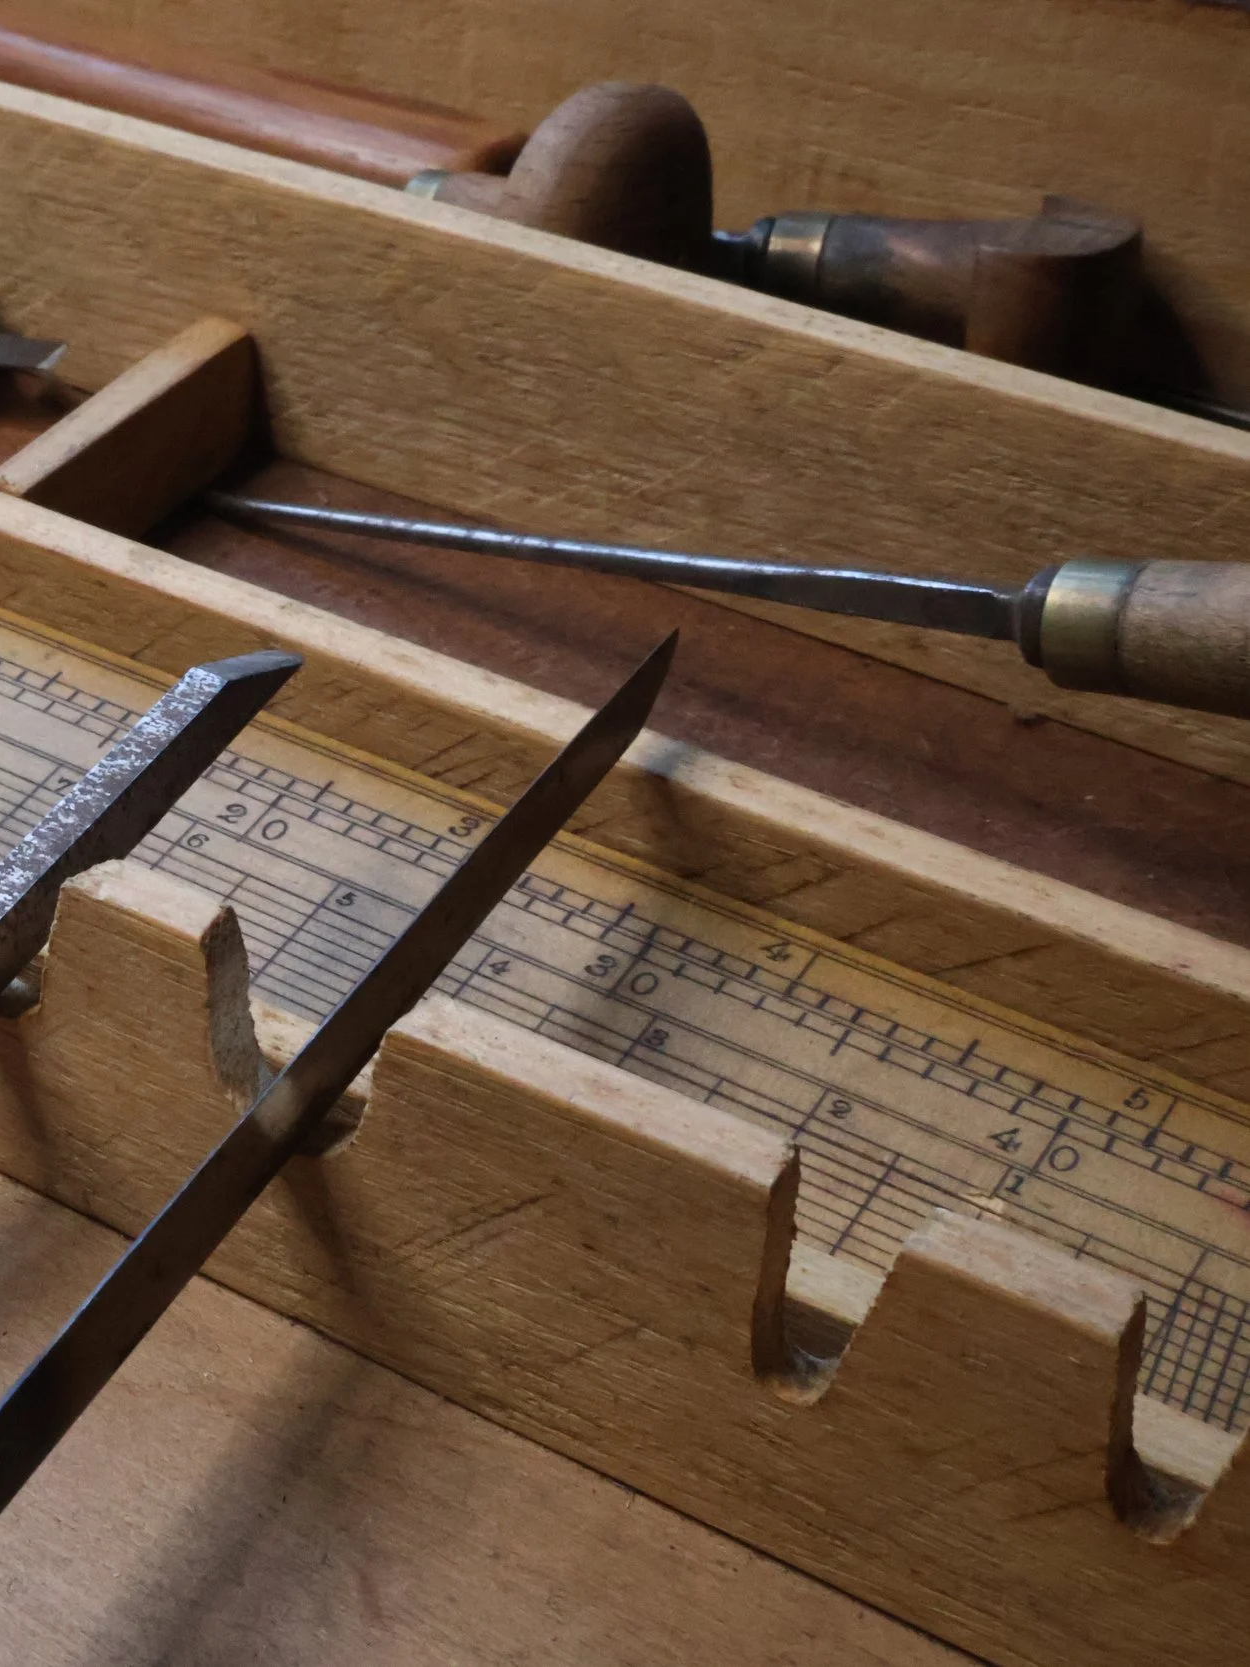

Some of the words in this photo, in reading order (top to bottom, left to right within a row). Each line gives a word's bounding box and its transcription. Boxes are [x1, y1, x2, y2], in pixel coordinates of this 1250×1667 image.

[449, 816, 480, 837] 3
[188, 833, 210, 848] 6
[335, 891, 355, 906] 5
[759, 942, 790, 962] 4
[489, 960, 511, 976] 4
[1123, 1087, 1150, 1110] 5
[829, 1099, 851, 1119] 2
[1005, 1174, 1024, 1196] 1
